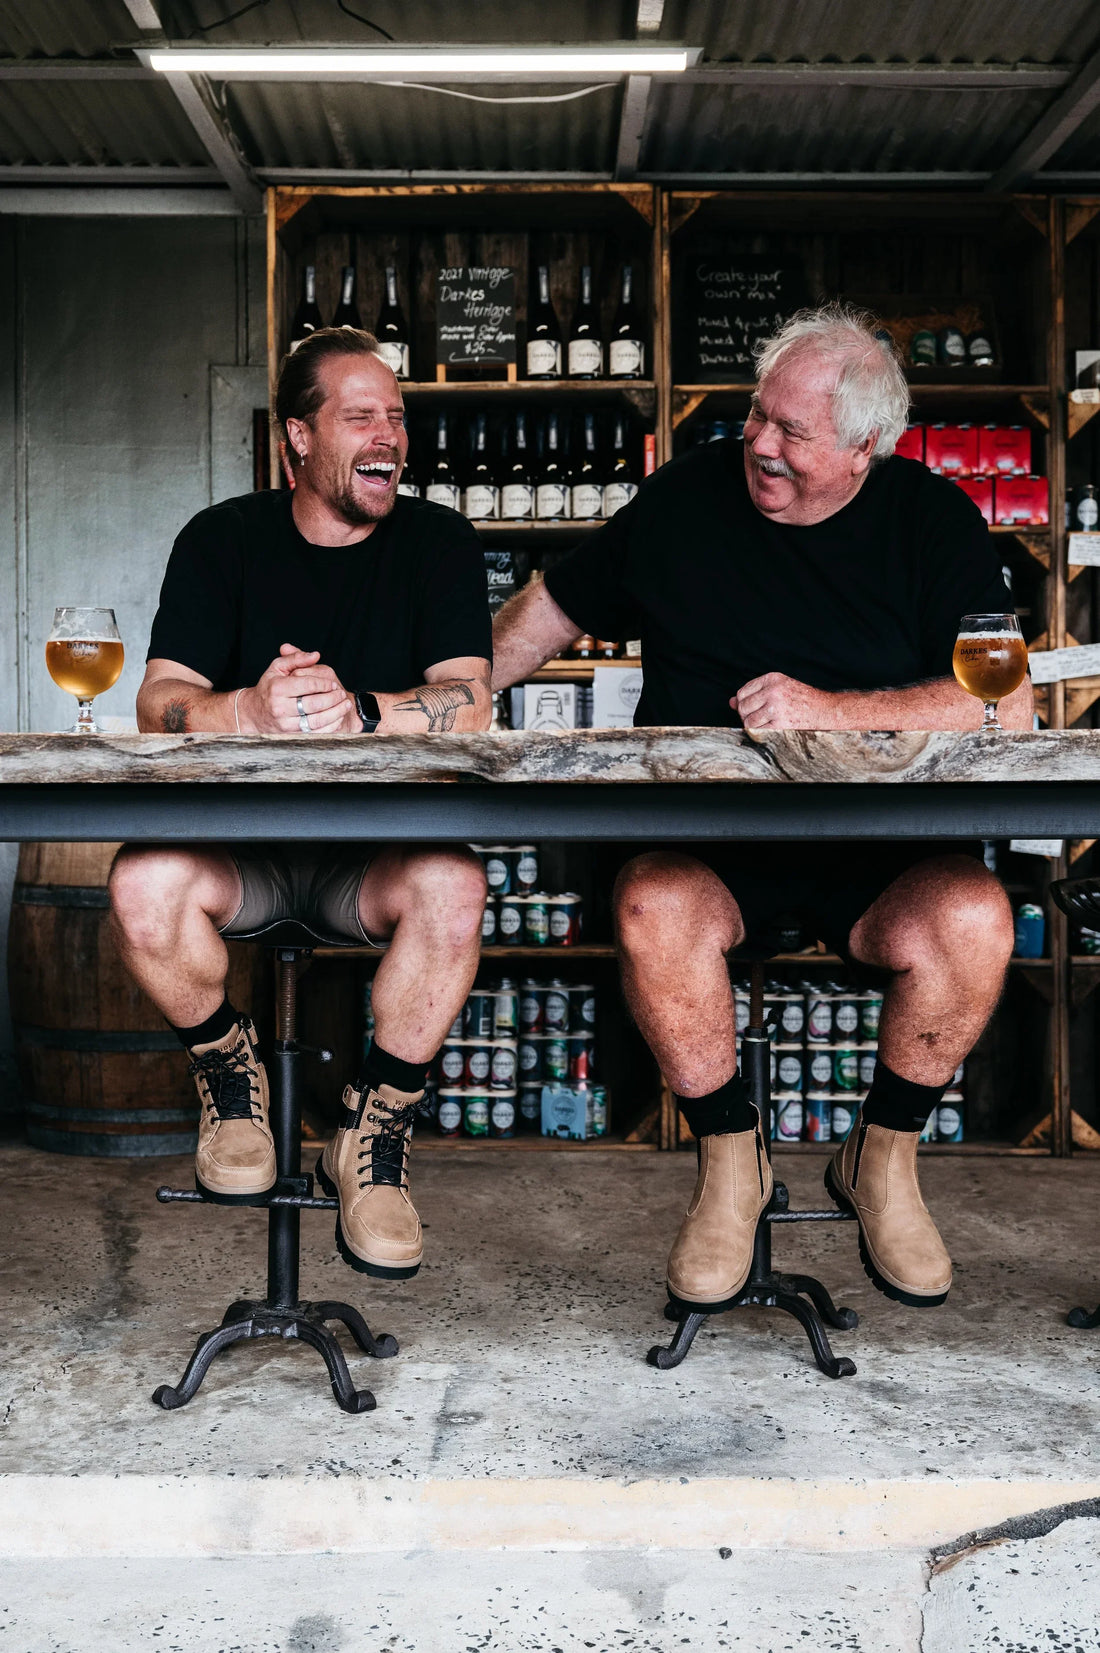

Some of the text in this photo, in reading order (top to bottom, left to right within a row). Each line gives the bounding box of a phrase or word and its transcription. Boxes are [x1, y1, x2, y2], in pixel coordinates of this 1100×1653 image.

[438, 268, 463, 281] 2021
[748, 270, 783, 291] your
[440, 285, 486, 302] Darkes
[704, 289, 741, 299] own
[960, 647, 988, 655] DARKES
